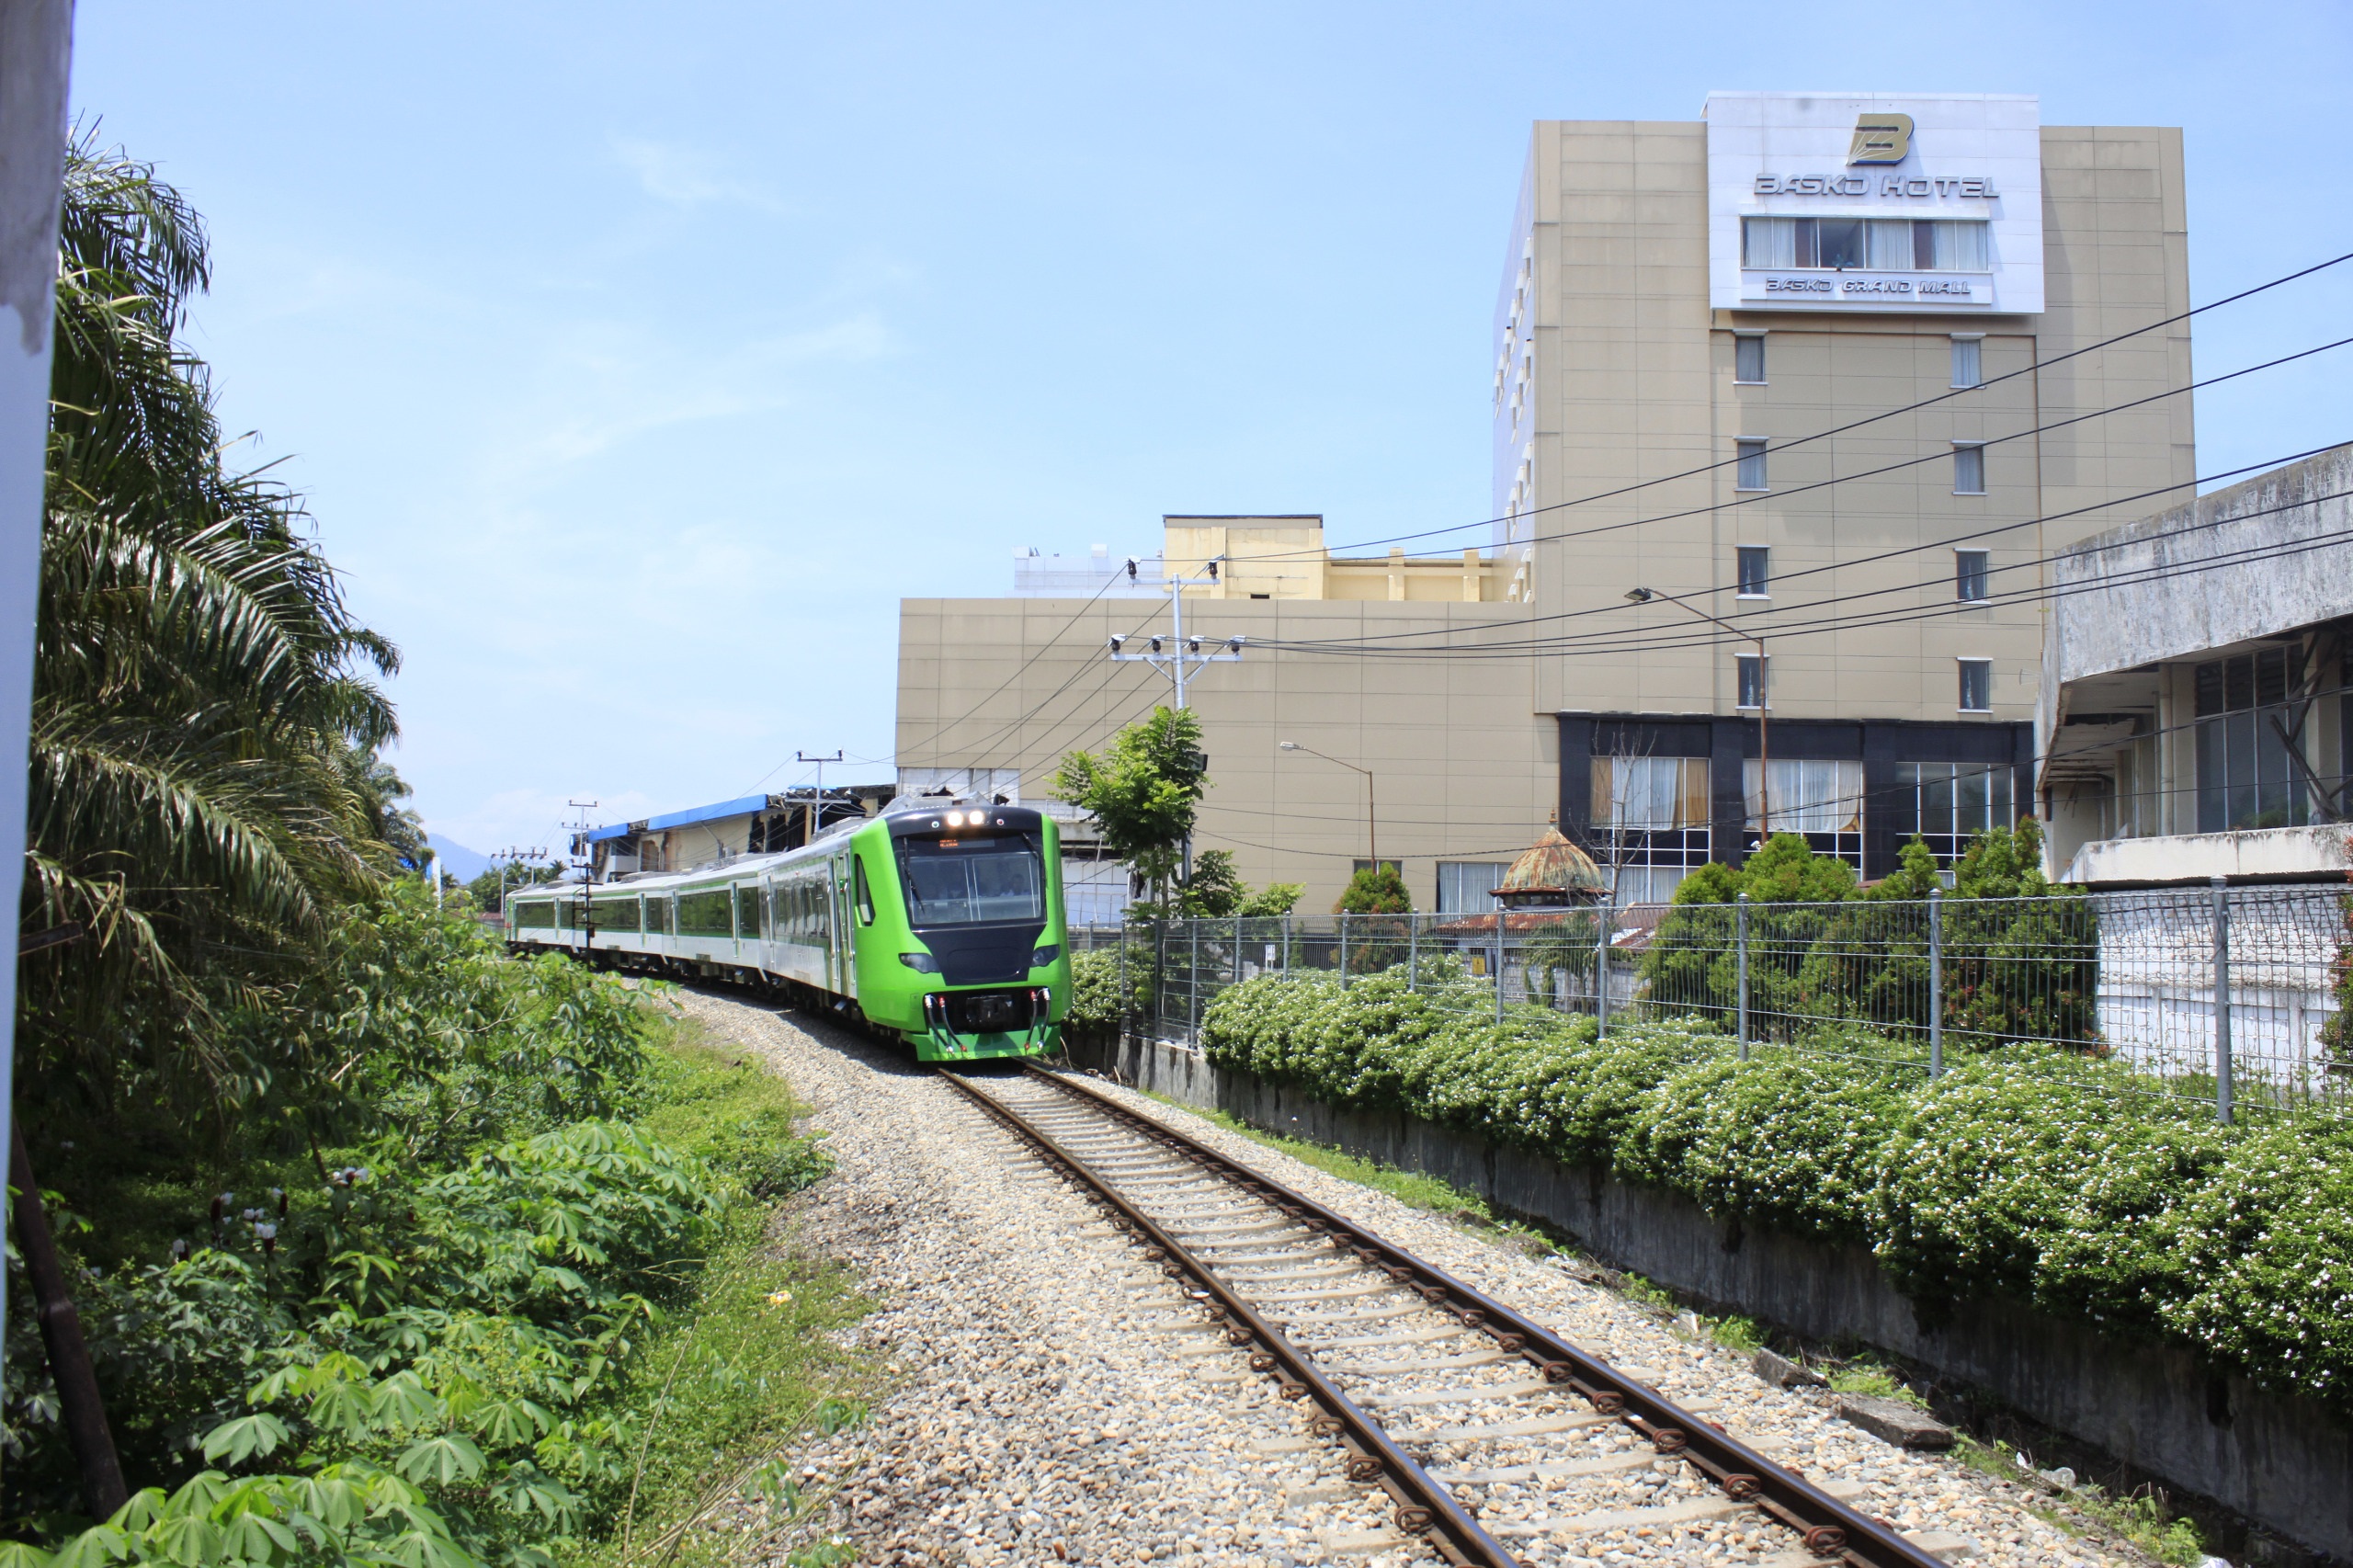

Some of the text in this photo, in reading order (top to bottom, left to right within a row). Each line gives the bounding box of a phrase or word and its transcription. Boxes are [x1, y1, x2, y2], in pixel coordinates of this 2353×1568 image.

[1754, 173, 2000, 198] BASKO HOTEL
[1766, 278, 1972, 295] BASKO GRAND MALL
